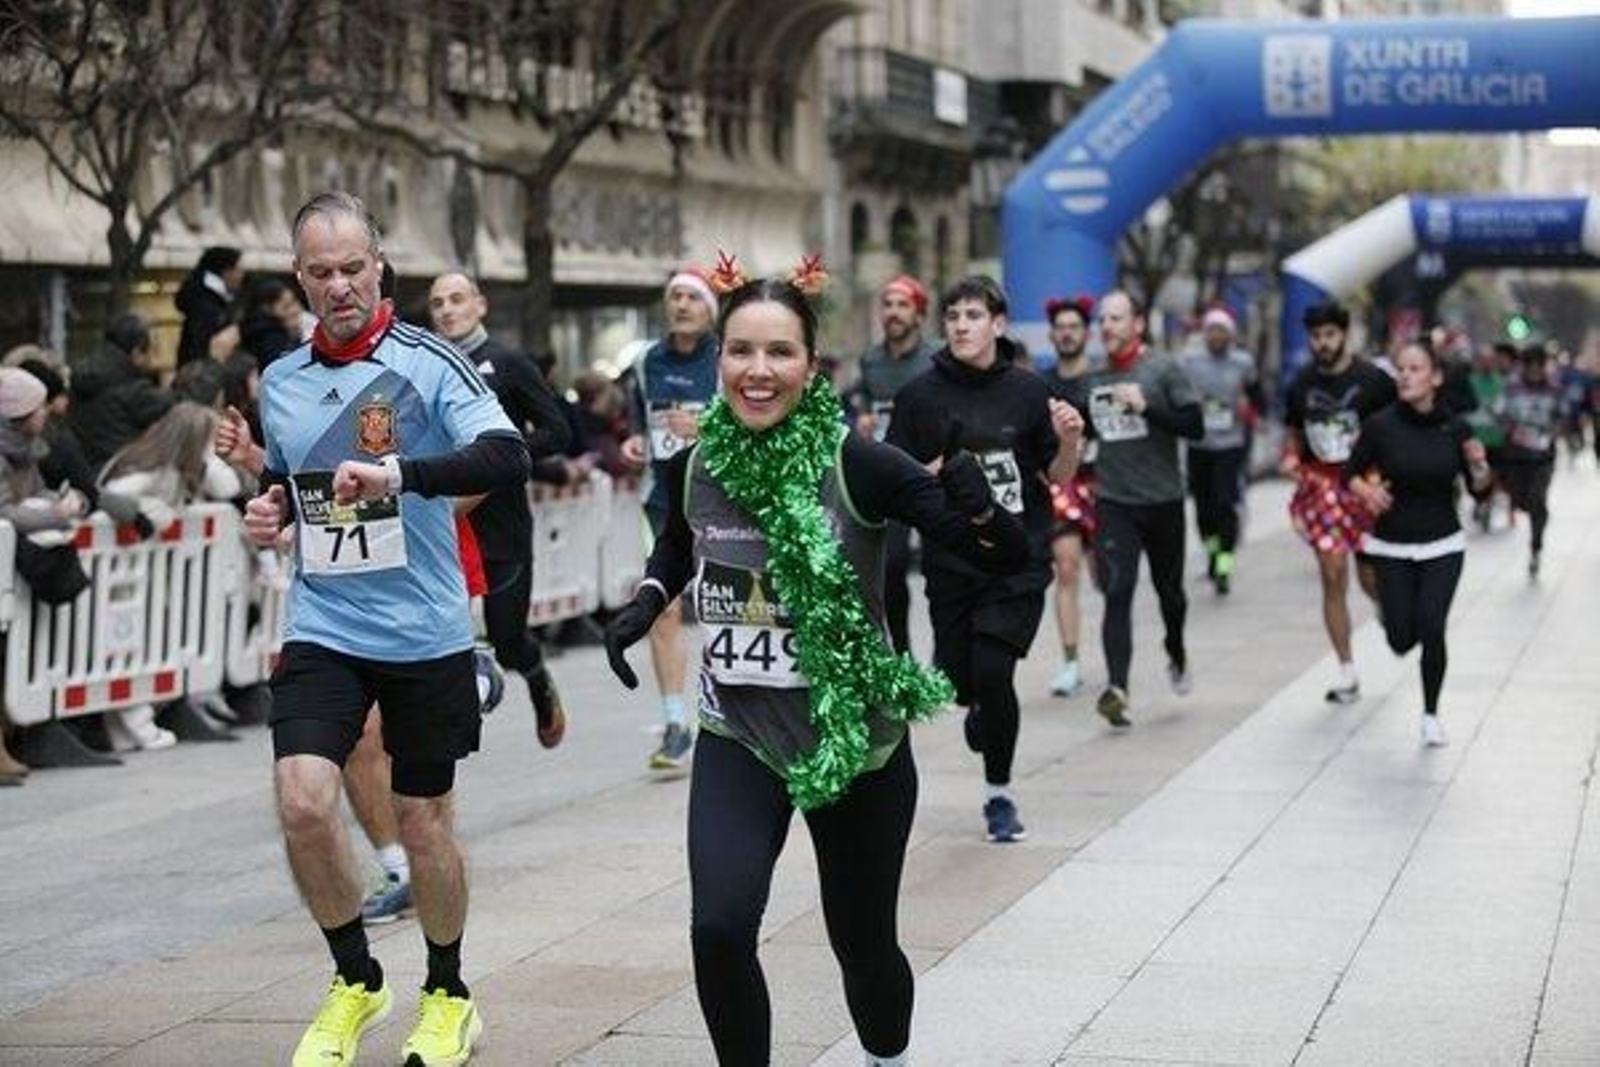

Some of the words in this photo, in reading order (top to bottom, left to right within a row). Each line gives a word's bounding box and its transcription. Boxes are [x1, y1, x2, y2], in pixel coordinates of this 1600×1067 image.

[1346, 39, 1469, 69] XUNTA
[1344, 73, 1390, 105] DE
[1398, 73, 1548, 106] GALICIA
[324, 524, 369, 562] 71
[702, 582, 734, 600] SAN
